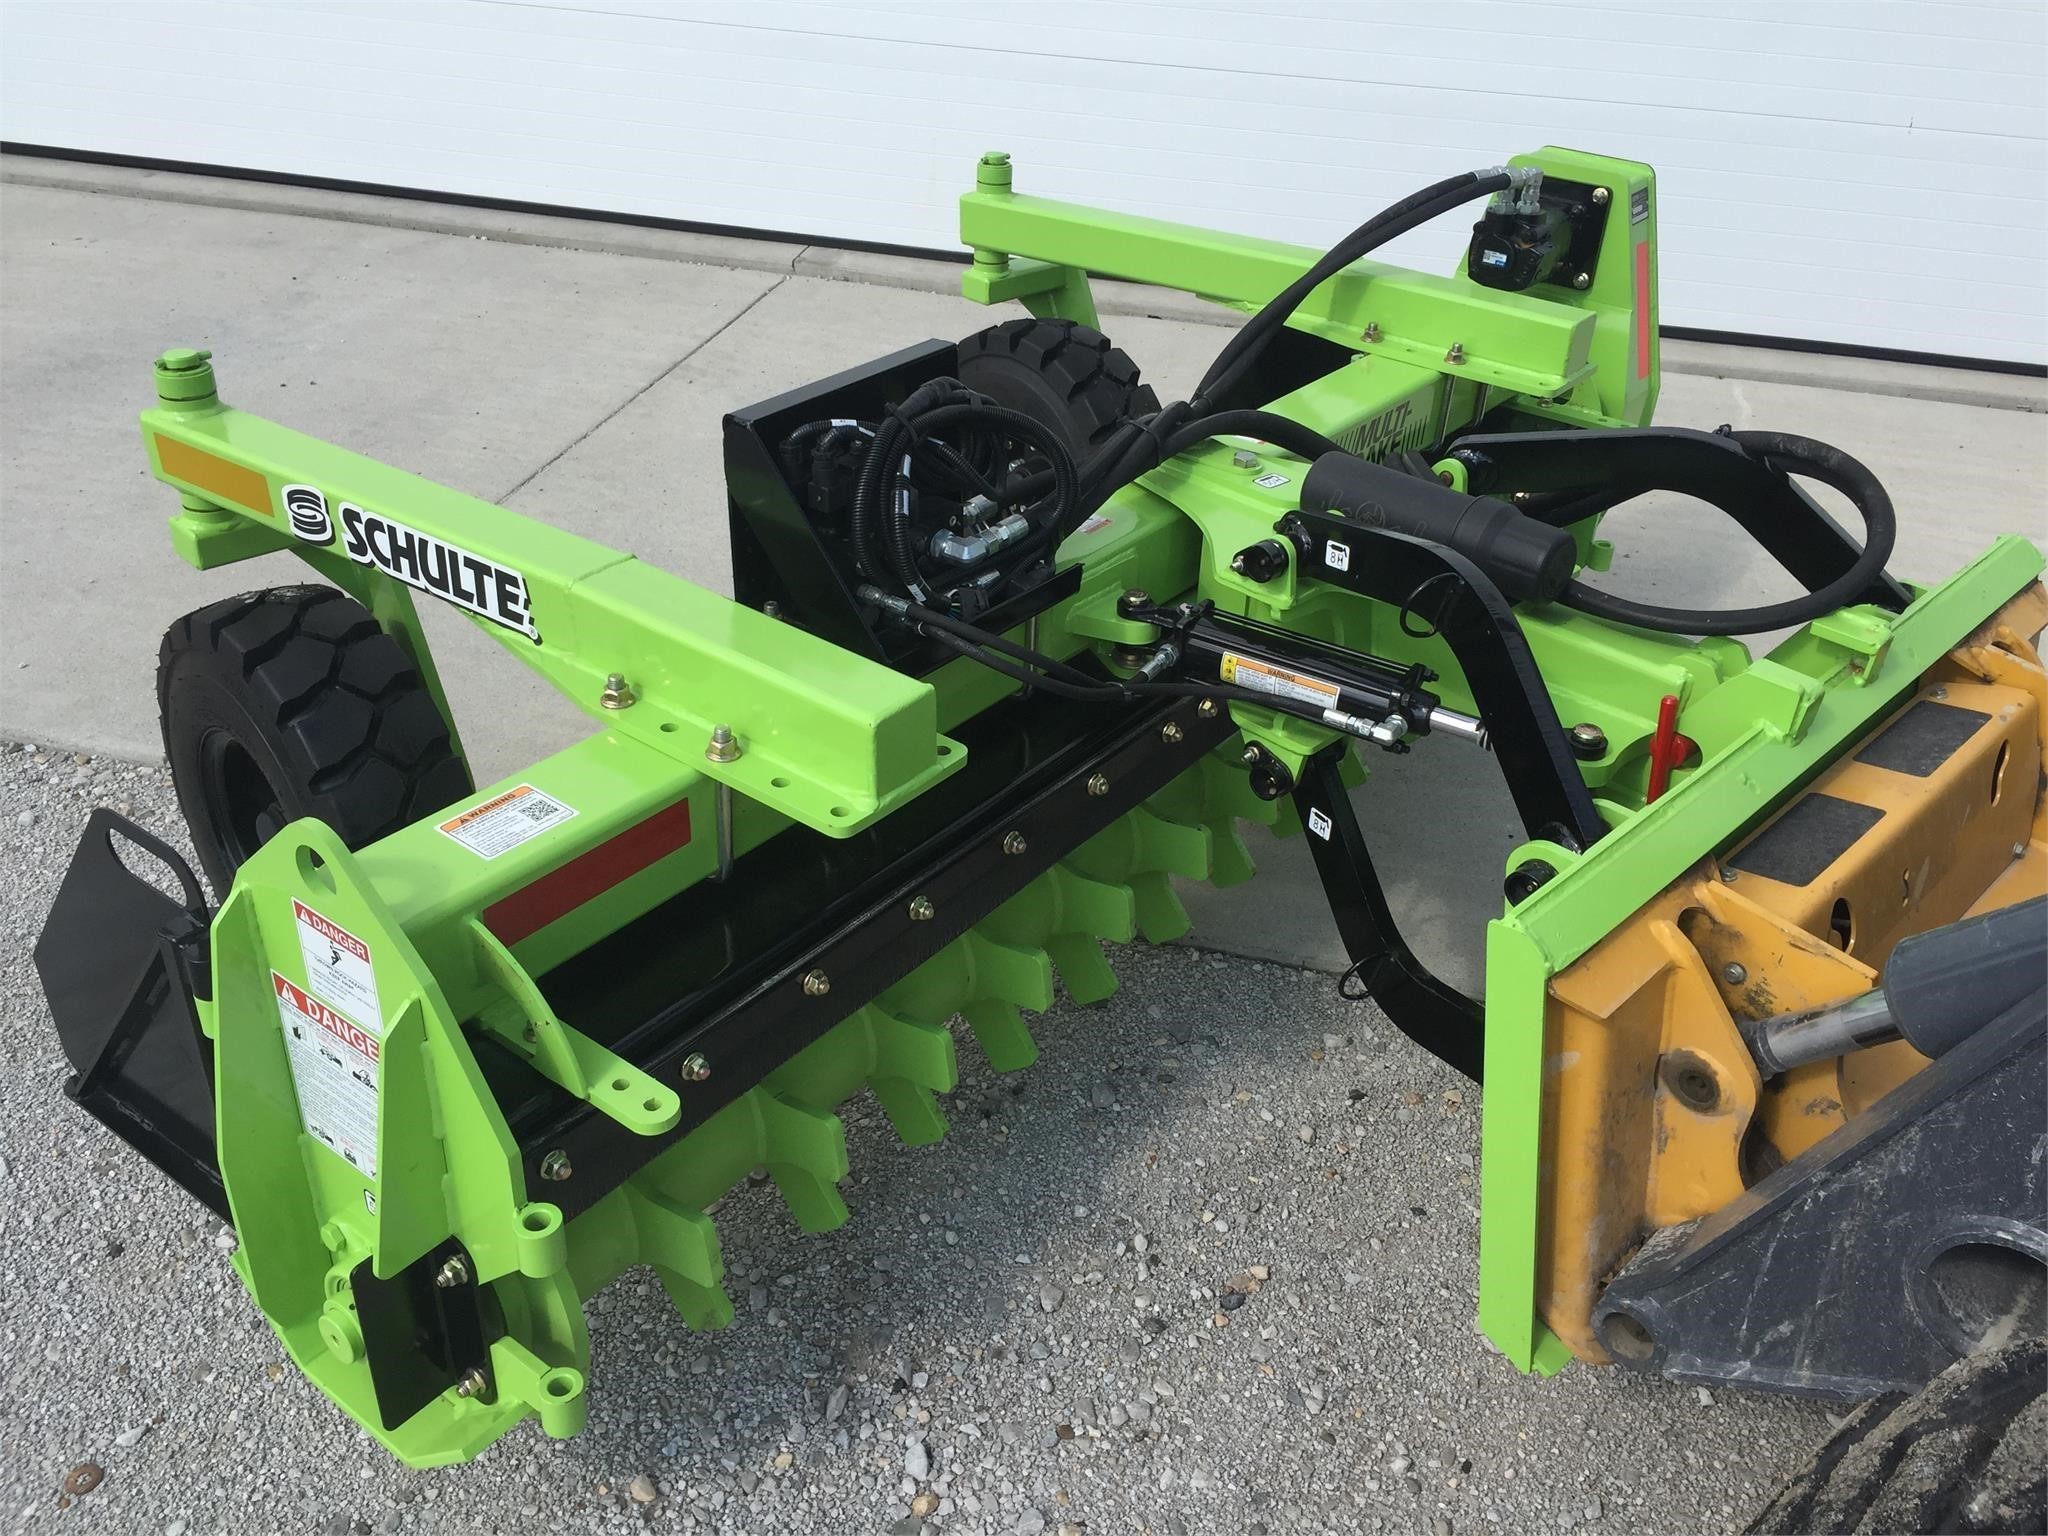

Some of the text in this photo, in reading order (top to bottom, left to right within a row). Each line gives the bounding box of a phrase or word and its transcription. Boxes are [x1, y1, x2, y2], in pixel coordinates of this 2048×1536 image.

[1359, 400, 1413, 451] MULTI-
[1360, 428, 1404, 465] AKE
[343, 507, 525, 626] SCHULTE
[1267, 667, 1296, 683] WARNING
[470, 793, 517, 818] WARNING
[312, 915, 366, 960] DANGER
[305, 996, 379, 1058] DANGE
